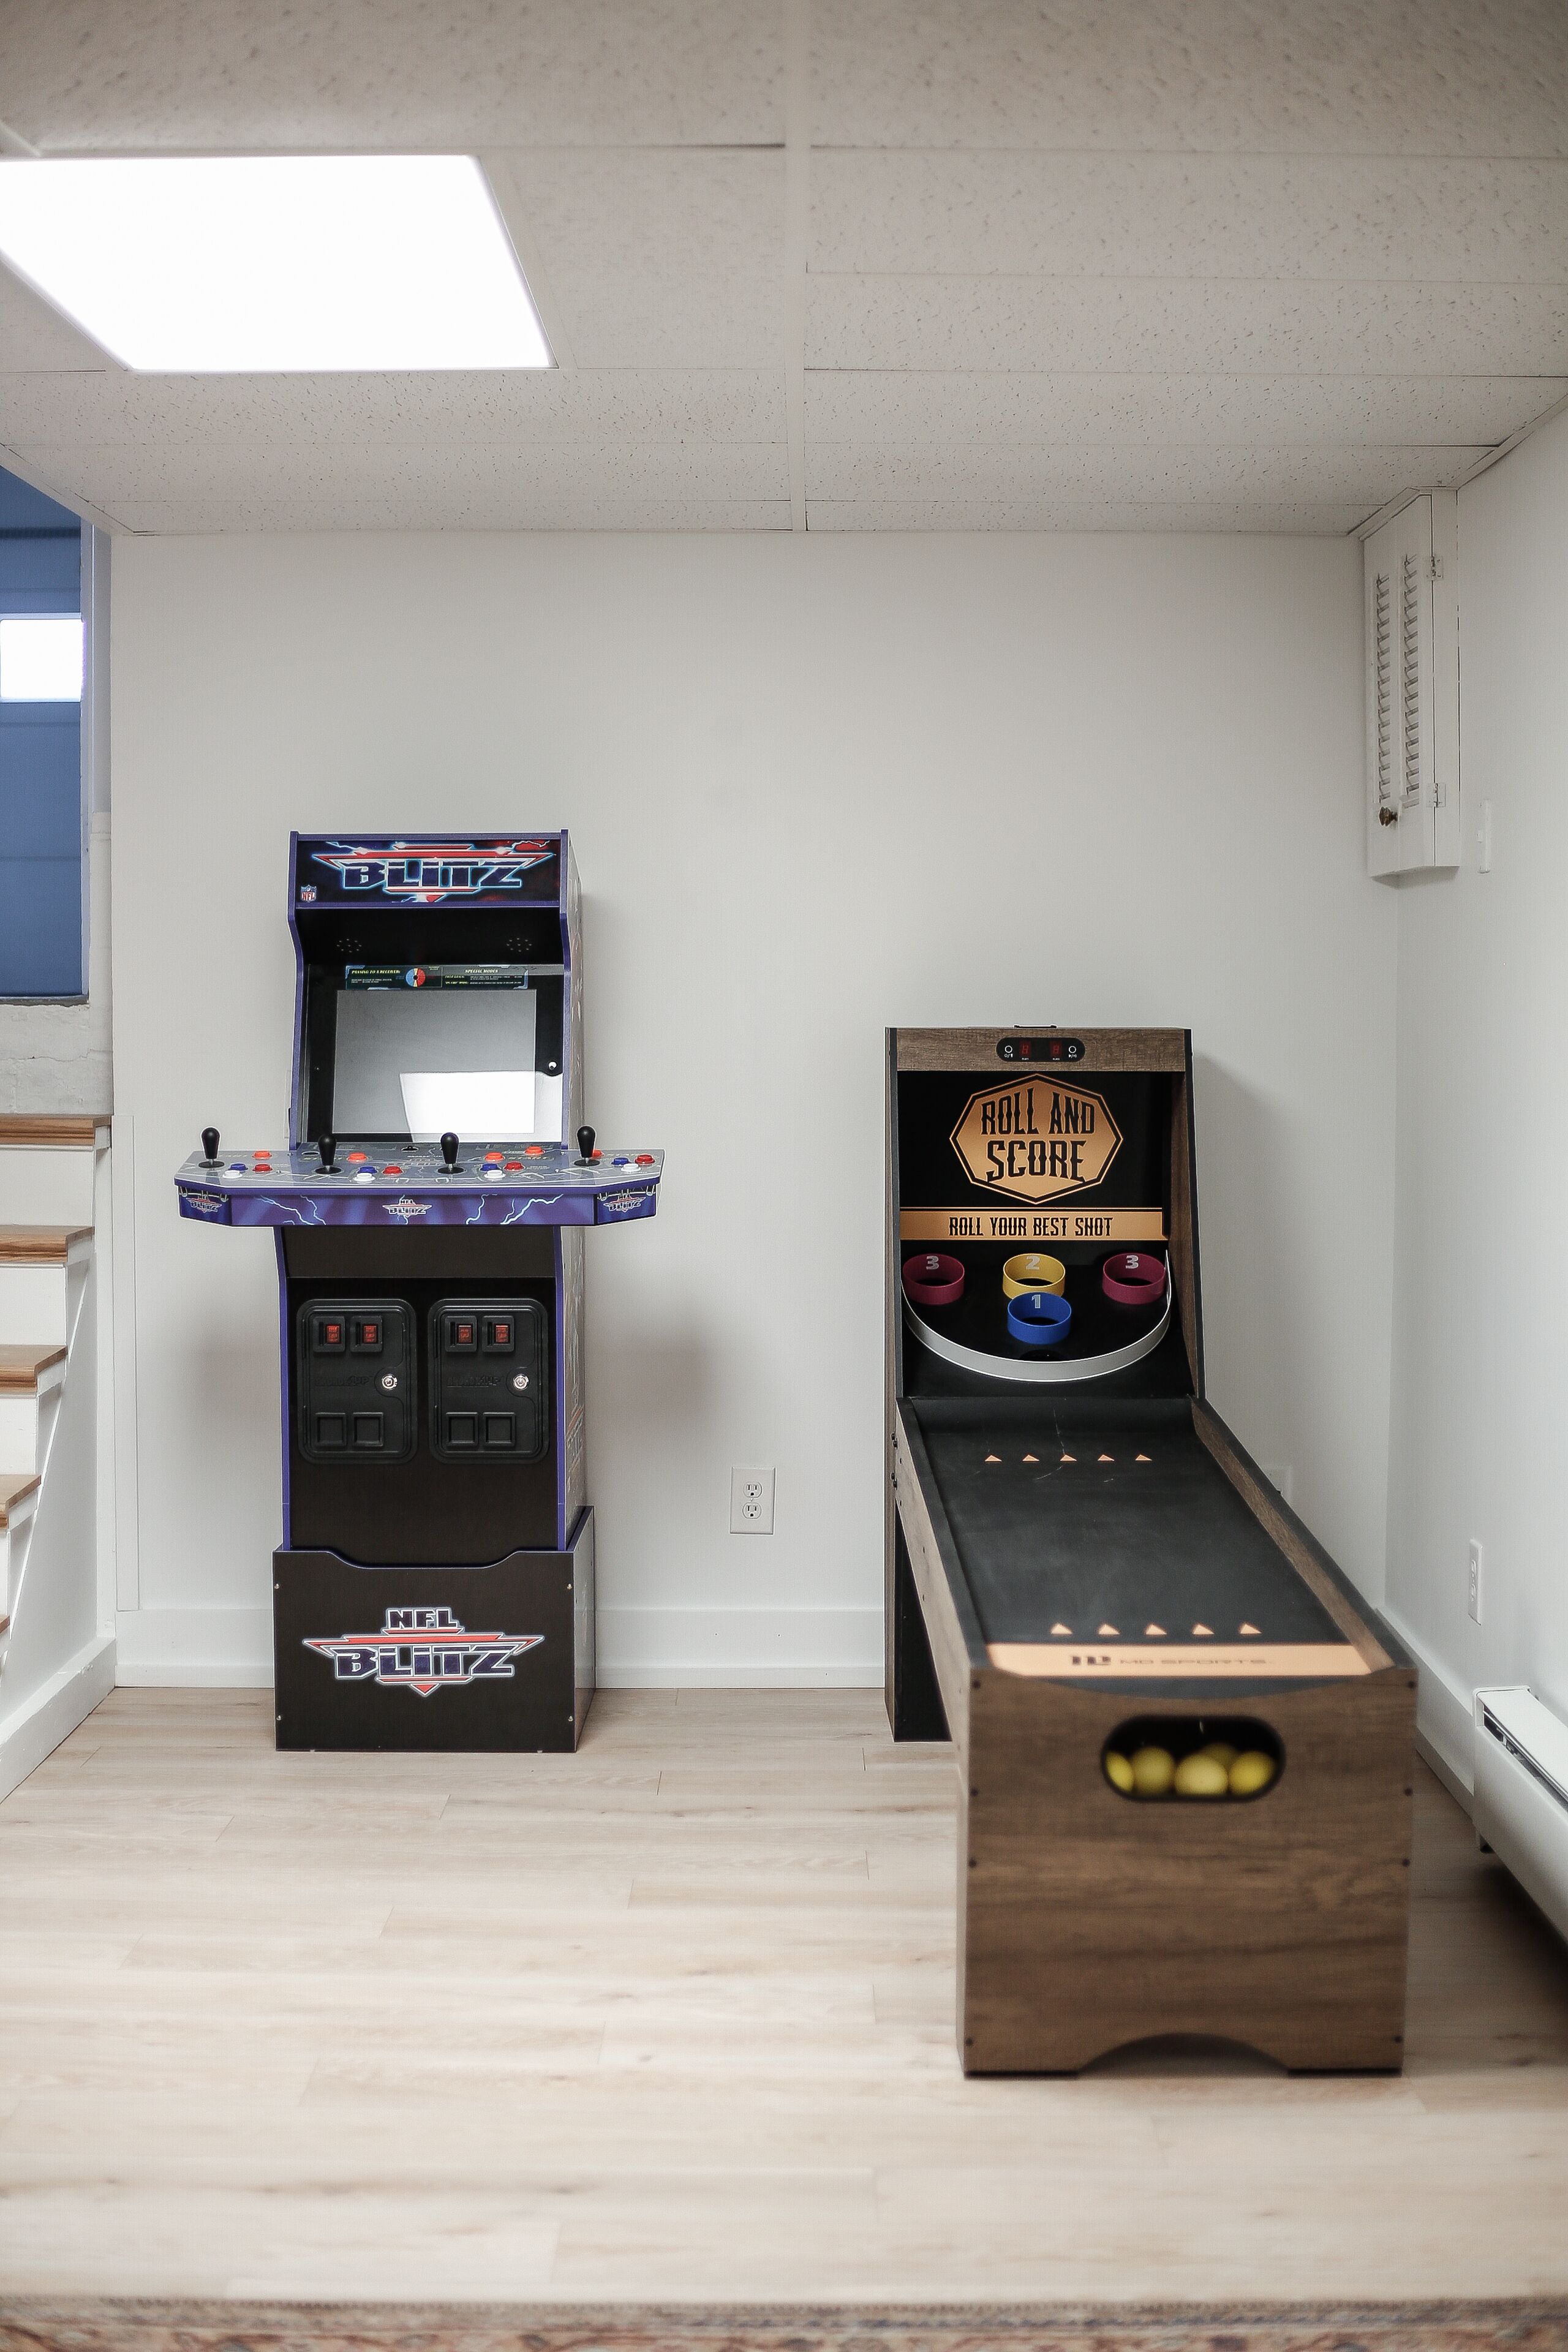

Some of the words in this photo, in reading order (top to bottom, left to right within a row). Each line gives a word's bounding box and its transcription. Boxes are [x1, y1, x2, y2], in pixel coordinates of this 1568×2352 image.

[339, 859, 529, 889] BLITZ
[301, 892, 315, 901] NFL
[981, 1087, 1040, 1136] ROLL
[1048, 1091, 1096, 1135] AND
[985, 1139, 1088, 1183] SCORE
[949, 1216, 984, 1237] ROLL
[989, 1216, 1027, 1237] YOUR
[1033, 1216, 1069, 1237] BEST
[1074, 1216, 1114, 1237] SHOT
[925, 1256, 940, 1270] 3
[1025, 1256, 1041, 1270] 2
[1125, 1255, 1139, 1269] 3
[1031, 1294, 1041, 1309] 1
[386, 1608, 459, 1629] NFL
[329, 1645, 519, 1679] BLITZ
